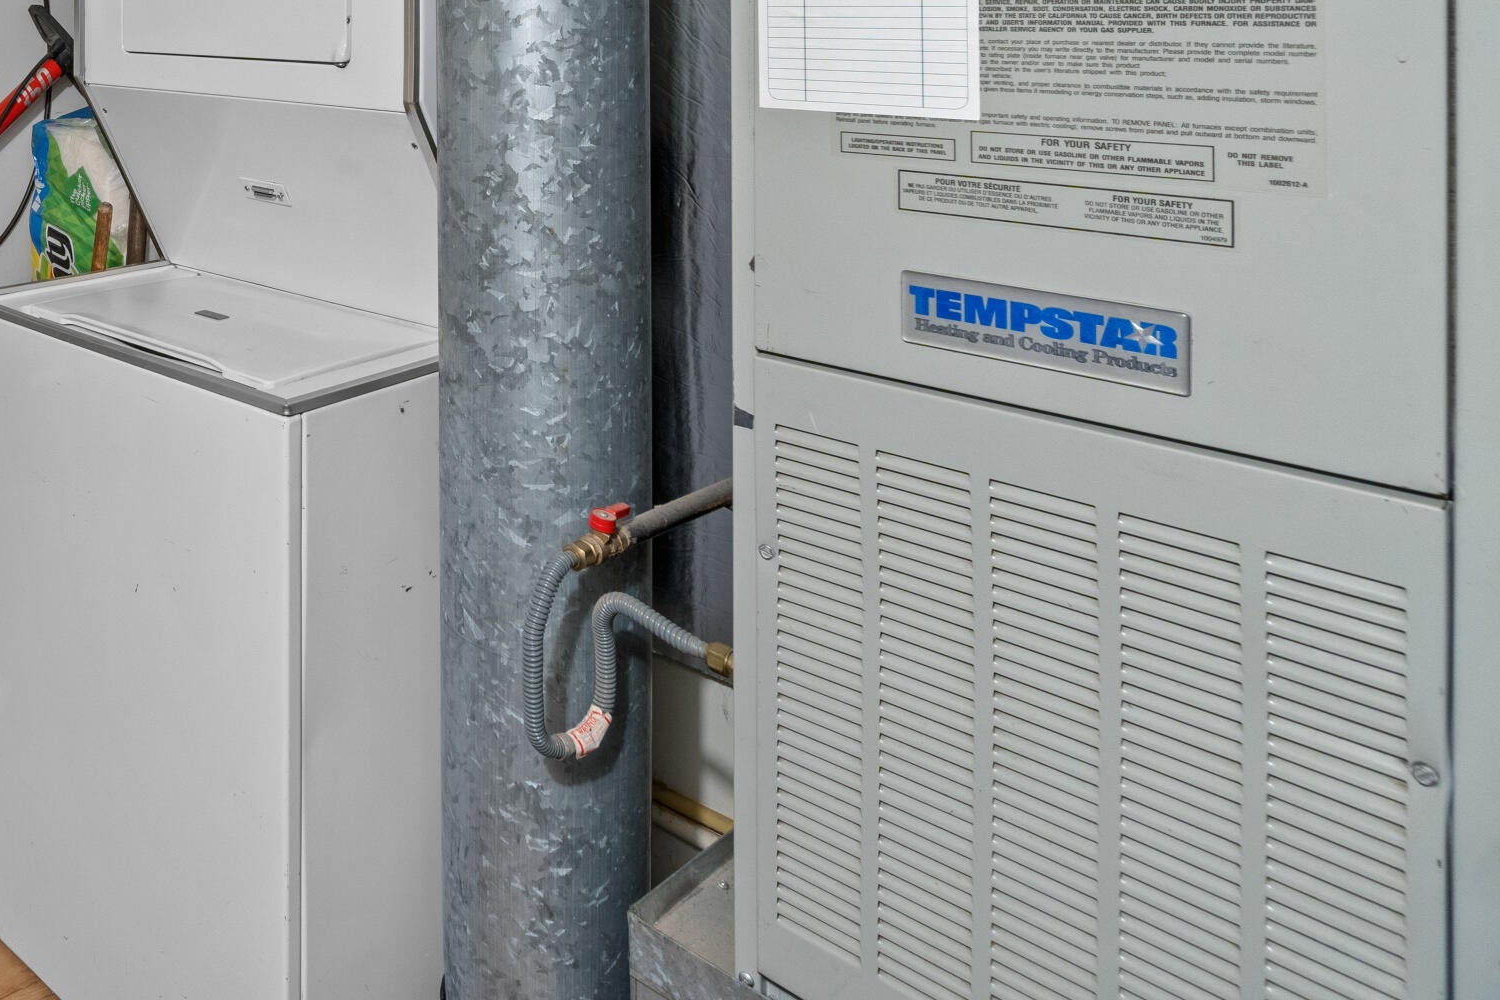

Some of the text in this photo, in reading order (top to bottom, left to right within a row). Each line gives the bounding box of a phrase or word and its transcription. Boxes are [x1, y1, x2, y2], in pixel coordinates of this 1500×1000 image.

[1041, 138, 1131, 151] FOR YOUR SAFETY
[1054, 151, 1086, 159] GASOLINE
[1127, 156, 1171, 165] FLAMMABLE
[1175, 159, 1204, 167] VAPORS
[1260, 154, 1293, 162] REMOVE
[1137, 165, 1160, 173] OTHER
[1164, 167, 1205, 176] APPLIANCE
[1258, 161, 1283, 169] LABEL
[935, 178, 955, 186] POUR
[957, 179, 981, 188] VOTRE
[1113, 195, 1192, 209] FOR YOUR SAFETY
[909, 284, 1178, 360] TEMPSTAR
[915, 317, 1177, 378] Heating and Cooling Products
